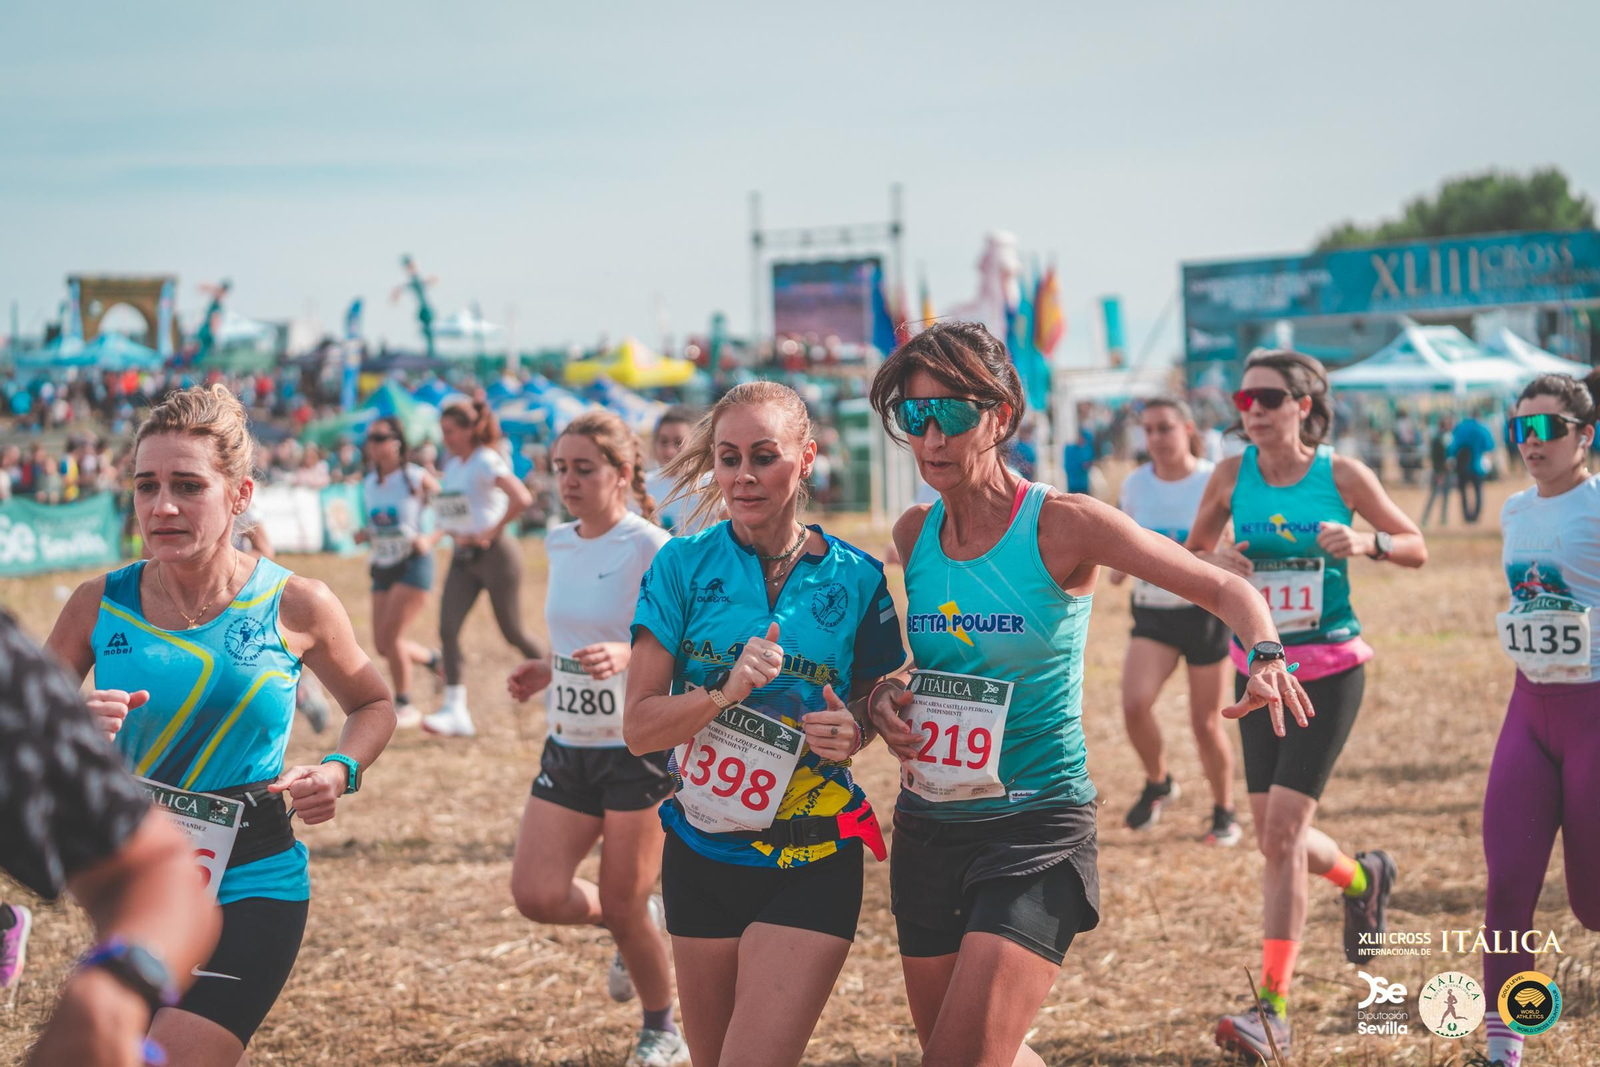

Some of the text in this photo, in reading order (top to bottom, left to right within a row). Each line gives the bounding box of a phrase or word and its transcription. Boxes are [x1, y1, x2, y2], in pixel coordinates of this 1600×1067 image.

[951, 612, 1025, 634] POWER
[1505, 621, 1582, 655] 1135
[103, 646, 133, 657] mobel
[922, 676, 972, 697] ITÁLICA
[556, 684, 616, 715] 1280
[943, 702, 968, 711] CASTELLO
[968, 706, 993, 714] PEDROSA
[926, 707, 962, 717] INDEPENDIENTE
[707, 731, 749, 753] INDEPENDIENTE
[757, 745, 782, 760] BLANCO
[679, 736, 777, 812] 1398
